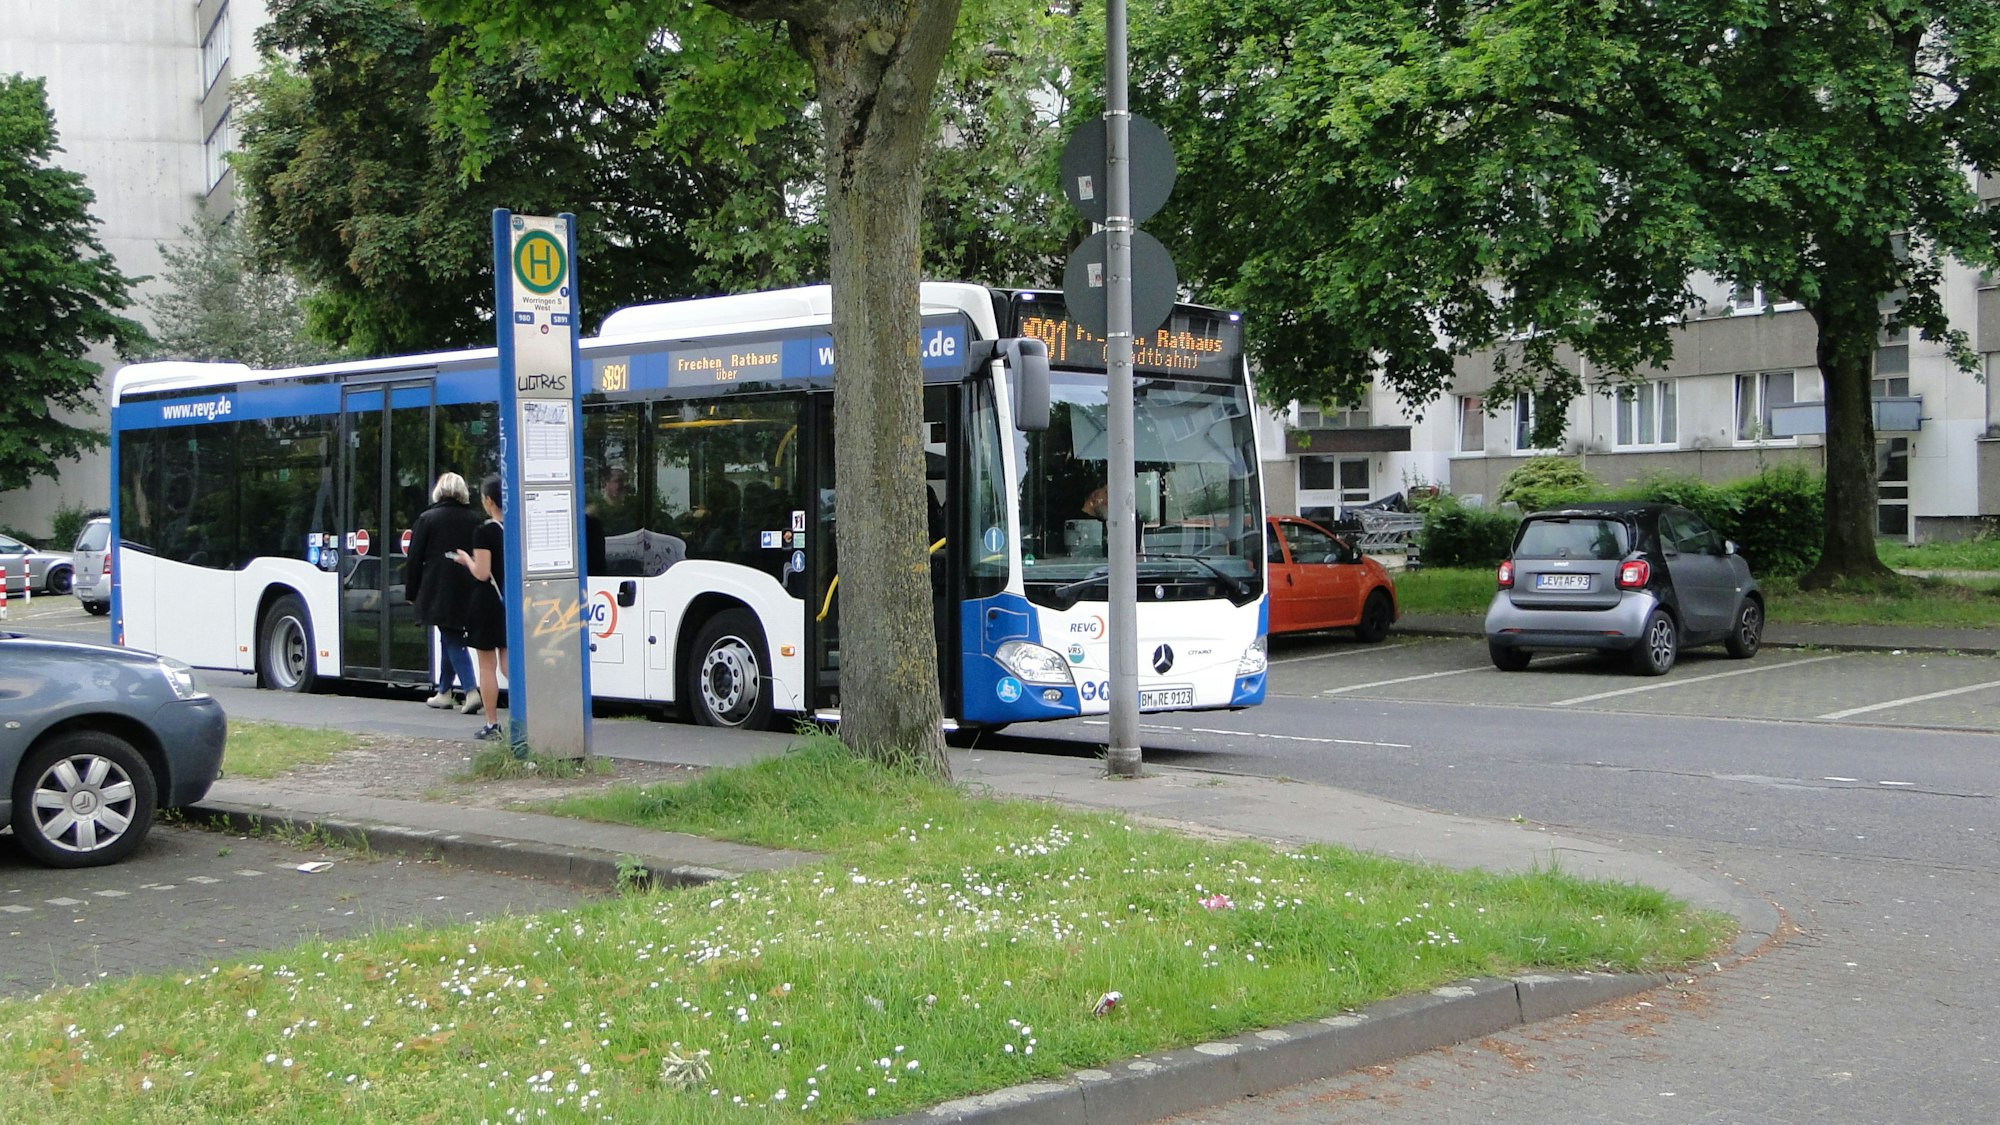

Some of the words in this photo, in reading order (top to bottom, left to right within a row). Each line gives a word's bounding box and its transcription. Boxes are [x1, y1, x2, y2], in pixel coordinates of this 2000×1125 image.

[529, 244, 551, 280] H
[522, 296, 556, 306] Worringen
[1157, 329, 1223, 353] Rathaus
[678, 356, 722, 372] Frechen
[731, 352, 778, 367] Rathaus
[716, 367, 738, 381] über
[163, 395, 232, 421] www.revg.de
[1542, 576, 1559, 586] LEV
[1564, 576, 1576, 586] AF
[1577, 576, 1589, 586] 93
[1070, 622, 1097, 633] REVG
[1068, 646, 1081, 654] VRS
[1141, 693, 1153, 707] BM
[1158, 692, 1169, 706] RE
[1171, 690, 1191, 705] 9123
